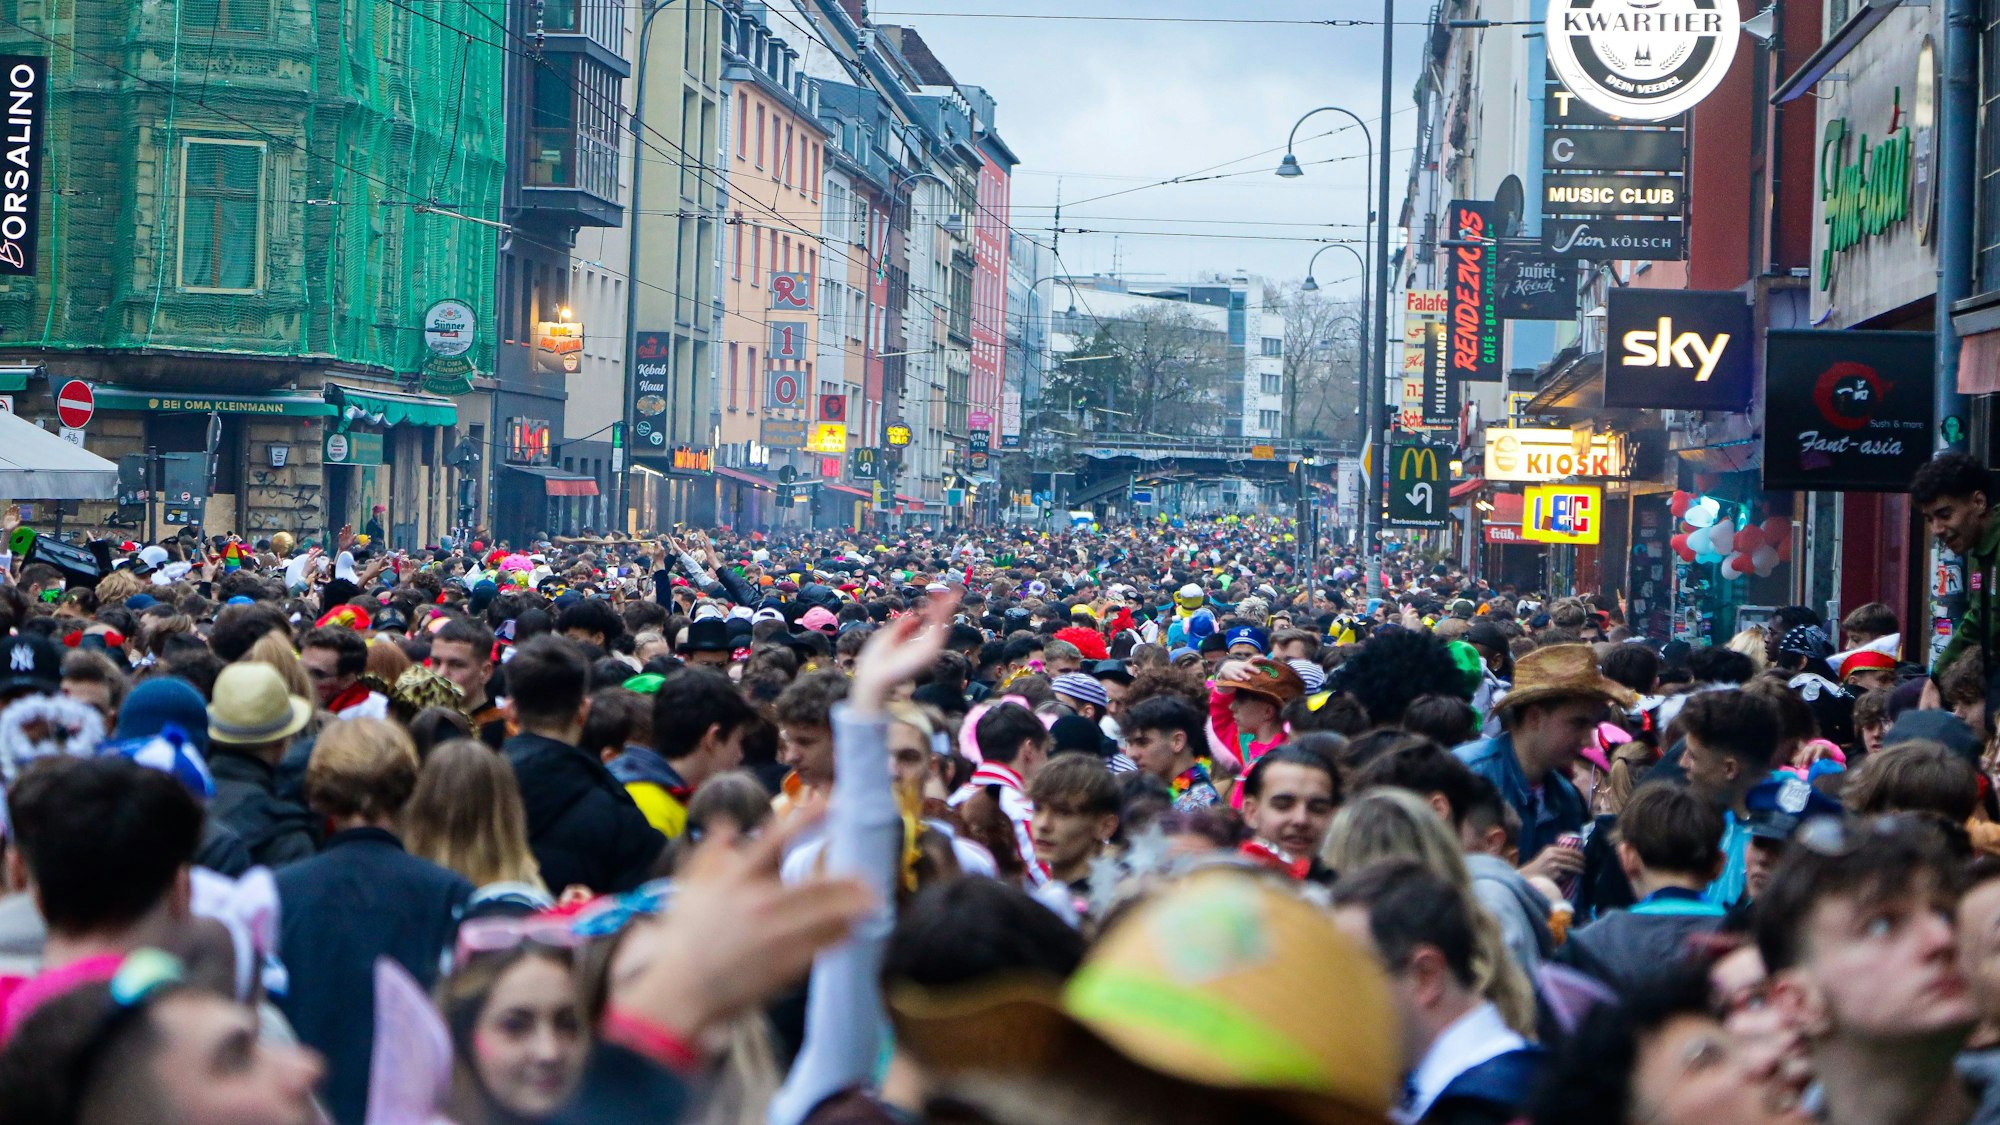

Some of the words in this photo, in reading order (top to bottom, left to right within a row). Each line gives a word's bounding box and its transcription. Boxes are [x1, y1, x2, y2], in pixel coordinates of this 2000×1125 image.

[1564, 12, 1722, 32] KWARTIER
[1605, 74, 1635, 93] DEIN
[1636, 76, 1683, 94] VEEDEL
[1552, 137, 1575, 162] C
[0, 64, 35, 269] BORSALINO
[1549, 187, 1615, 204] MUSIC
[1620, 188, 1675, 204] CLUB
[1552, 224, 1607, 252] Sion
[1611, 235, 1672, 248] KÖLSCH
[1407, 293, 1448, 312] Falafe
[1484, 335, 1496, 364] CAFÉ
[1622, 316, 1731, 382] sky
[638, 363, 667, 377] Kebab
[639, 381, 664, 392] Haus
[163, 400, 181, 409] BEI
[184, 401, 212, 410] OMA
[215, 401, 284, 413] KLEINMANN
[887, 426, 911, 436] SOUL
[890, 436, 908, 445] BAR
[1799, 431, 1904, 455] Fant-asia
[1527, 453, 1607, 475] KIOSK
